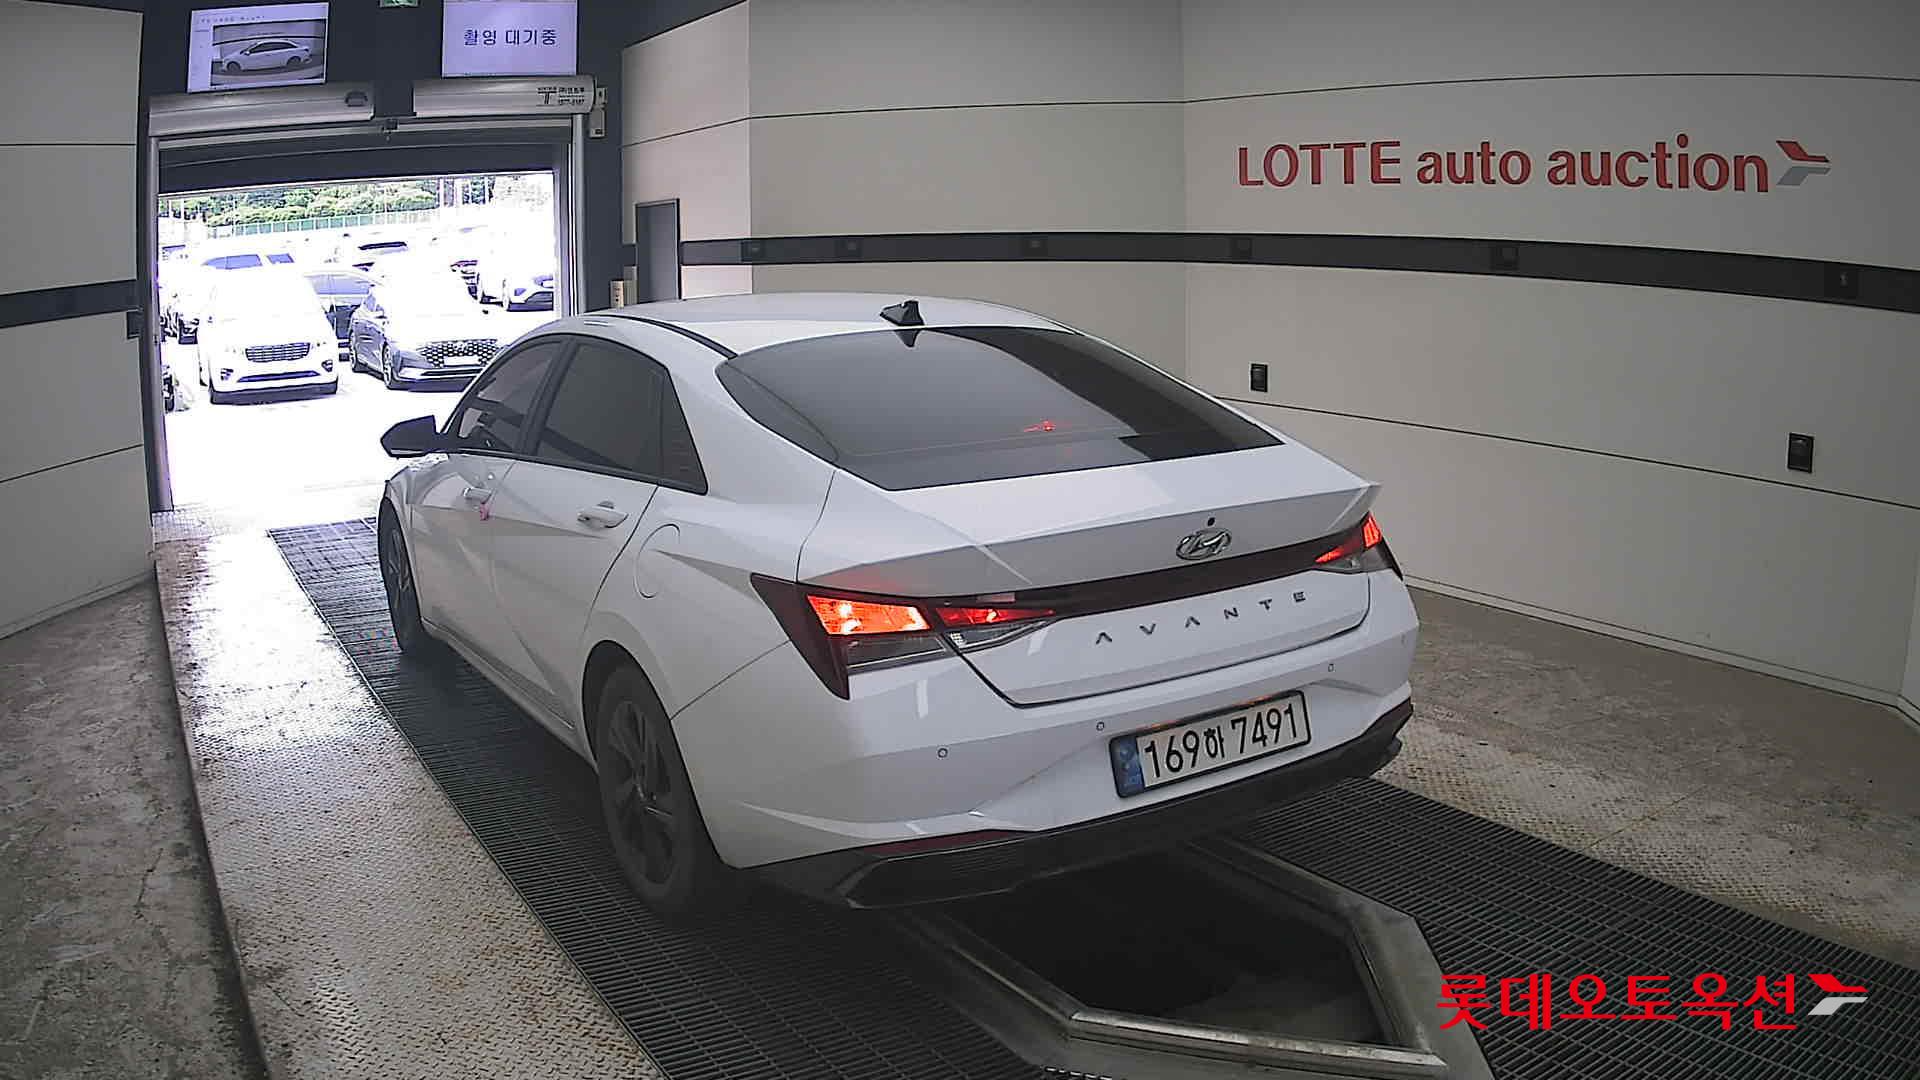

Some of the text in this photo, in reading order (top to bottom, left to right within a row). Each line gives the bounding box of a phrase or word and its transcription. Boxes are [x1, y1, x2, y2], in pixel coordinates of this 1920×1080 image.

[464, 29, 557, 46] 촬영 대기중
[1238, 134, 1769, 193] LOTTE auto auction
[1095, 591, 1306, 645] AVANTE
[1144, 703, 1297, 778] 169하 7491
